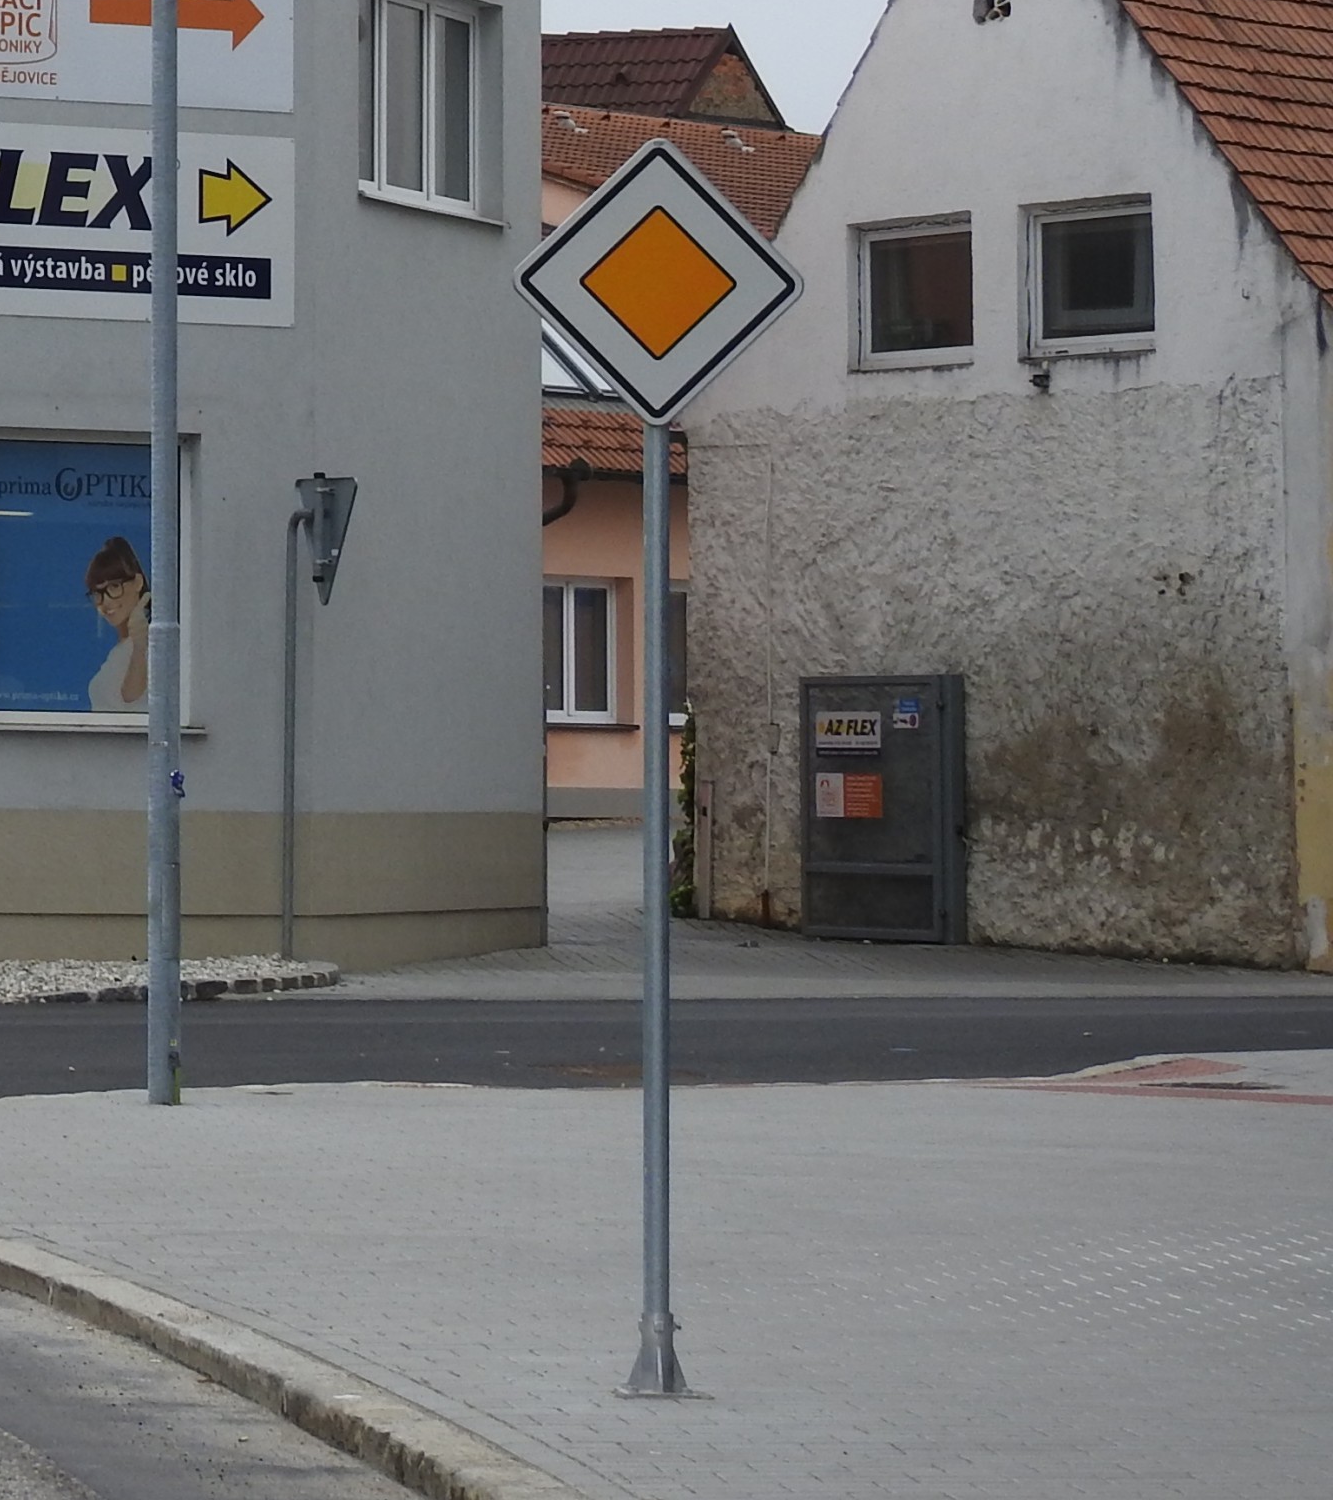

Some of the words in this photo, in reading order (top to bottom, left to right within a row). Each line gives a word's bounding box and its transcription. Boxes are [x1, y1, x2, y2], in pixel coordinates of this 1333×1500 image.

[11, 254, 106, 283] výstavba
[214, 263, 257, 288] sklo
[55, 467, 152, 501] OPTIK
[824, 719, 843, 736] AZ
[846, 719, 878, 736] FLEX
